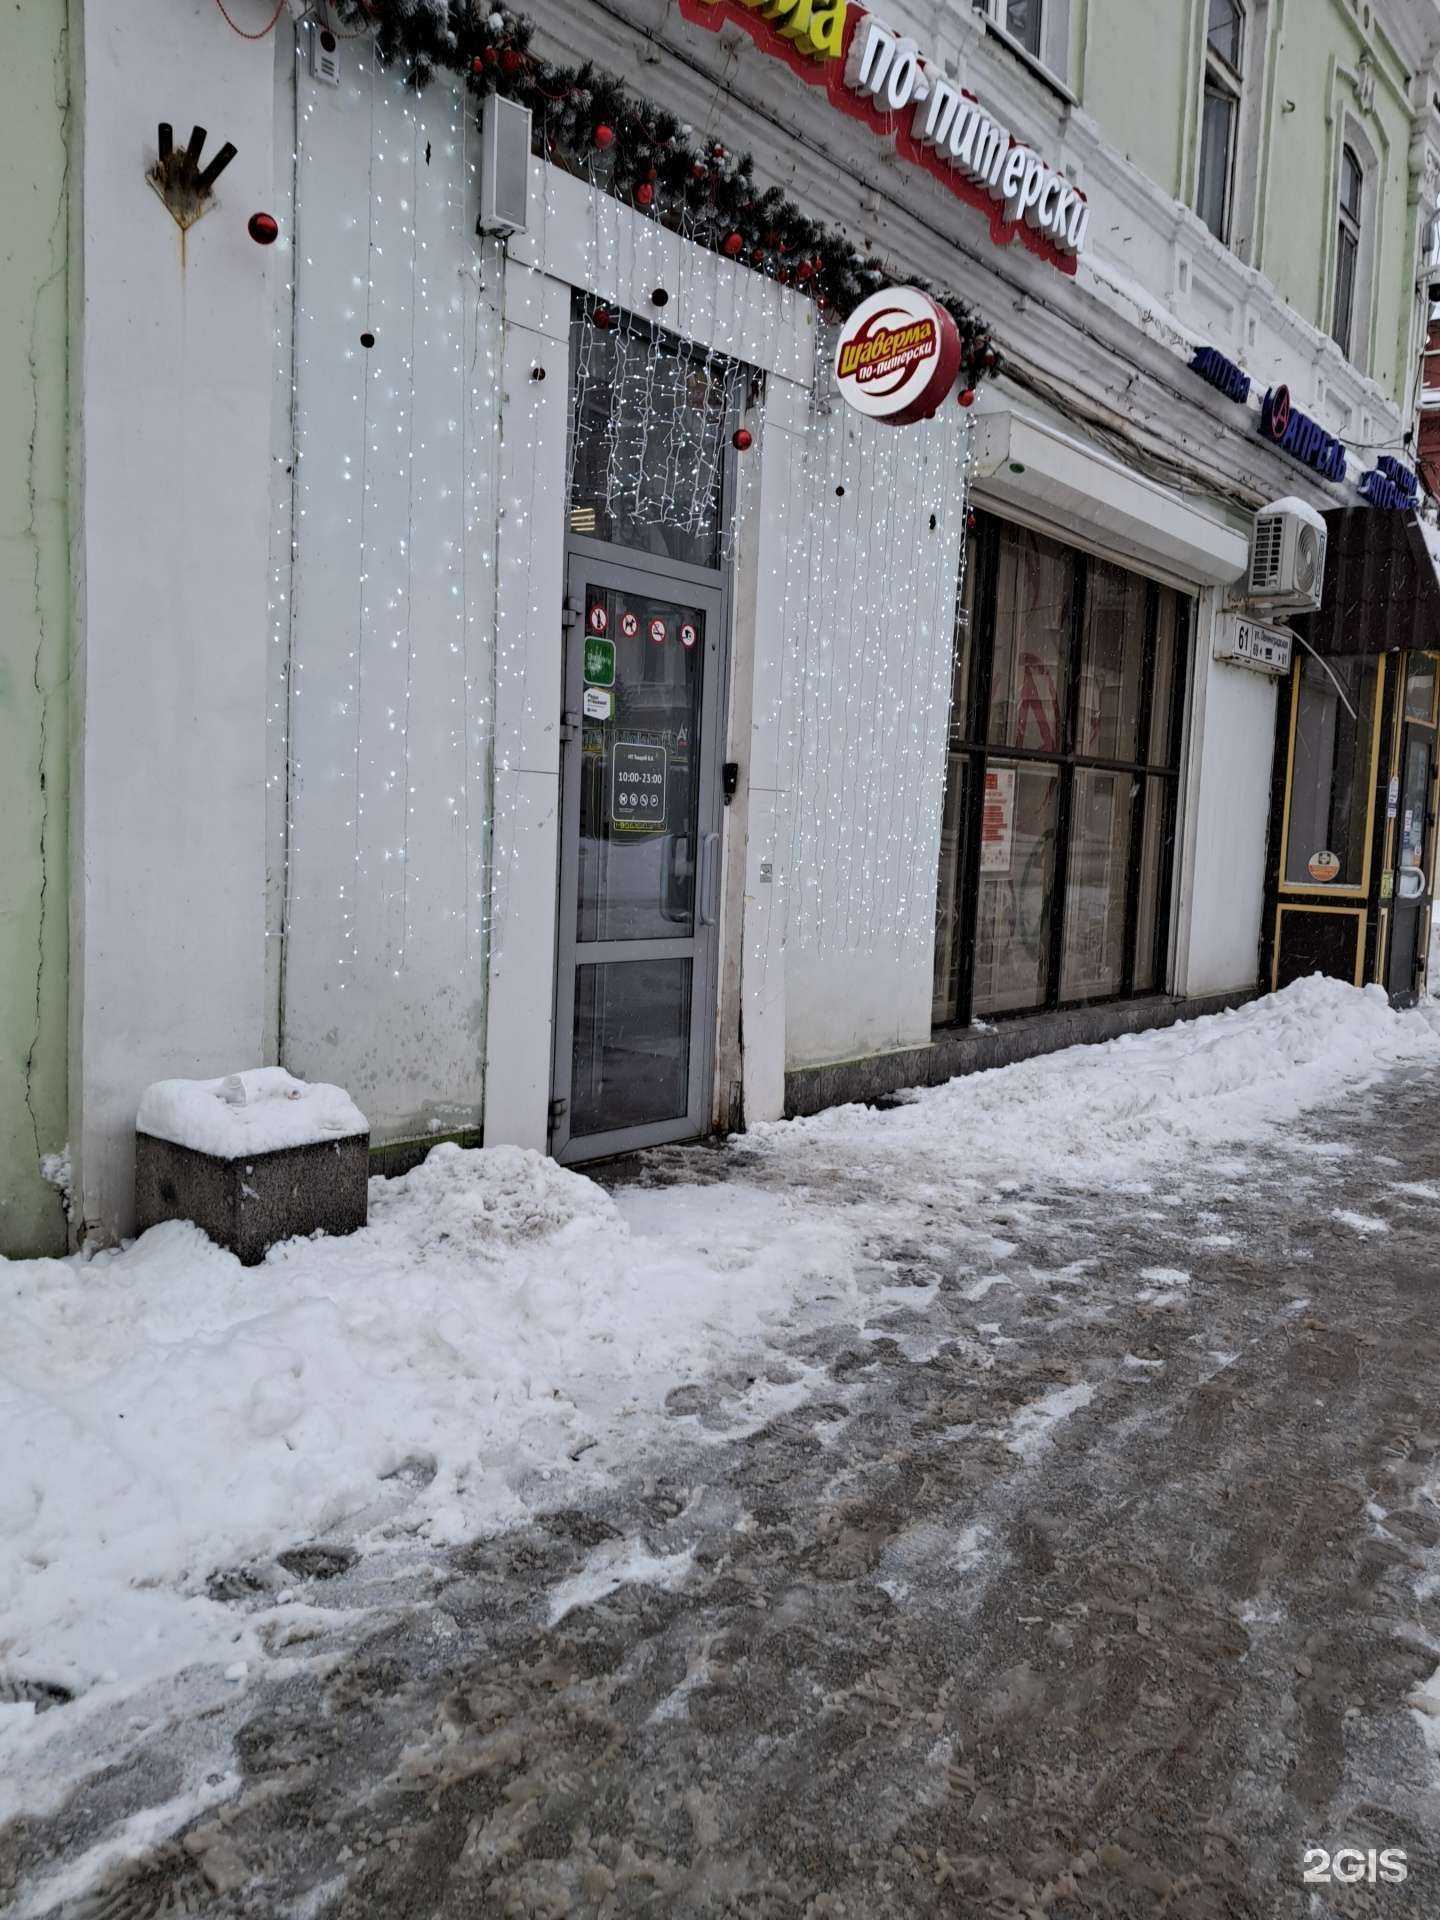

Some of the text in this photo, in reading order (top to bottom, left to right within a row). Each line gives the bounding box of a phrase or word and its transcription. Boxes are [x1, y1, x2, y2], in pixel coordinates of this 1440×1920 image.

[858, 22, 1090, 254] по-питерски
[840, 321, 932, 375] Шаверма
[858, 340, 934, 381] по-питерски
[1280, 407, 1347, 483] АПРЕЛЬ
[1238, 625, 1249, 651] 61
[617, 771, 663, 785] 10:00-23:00
